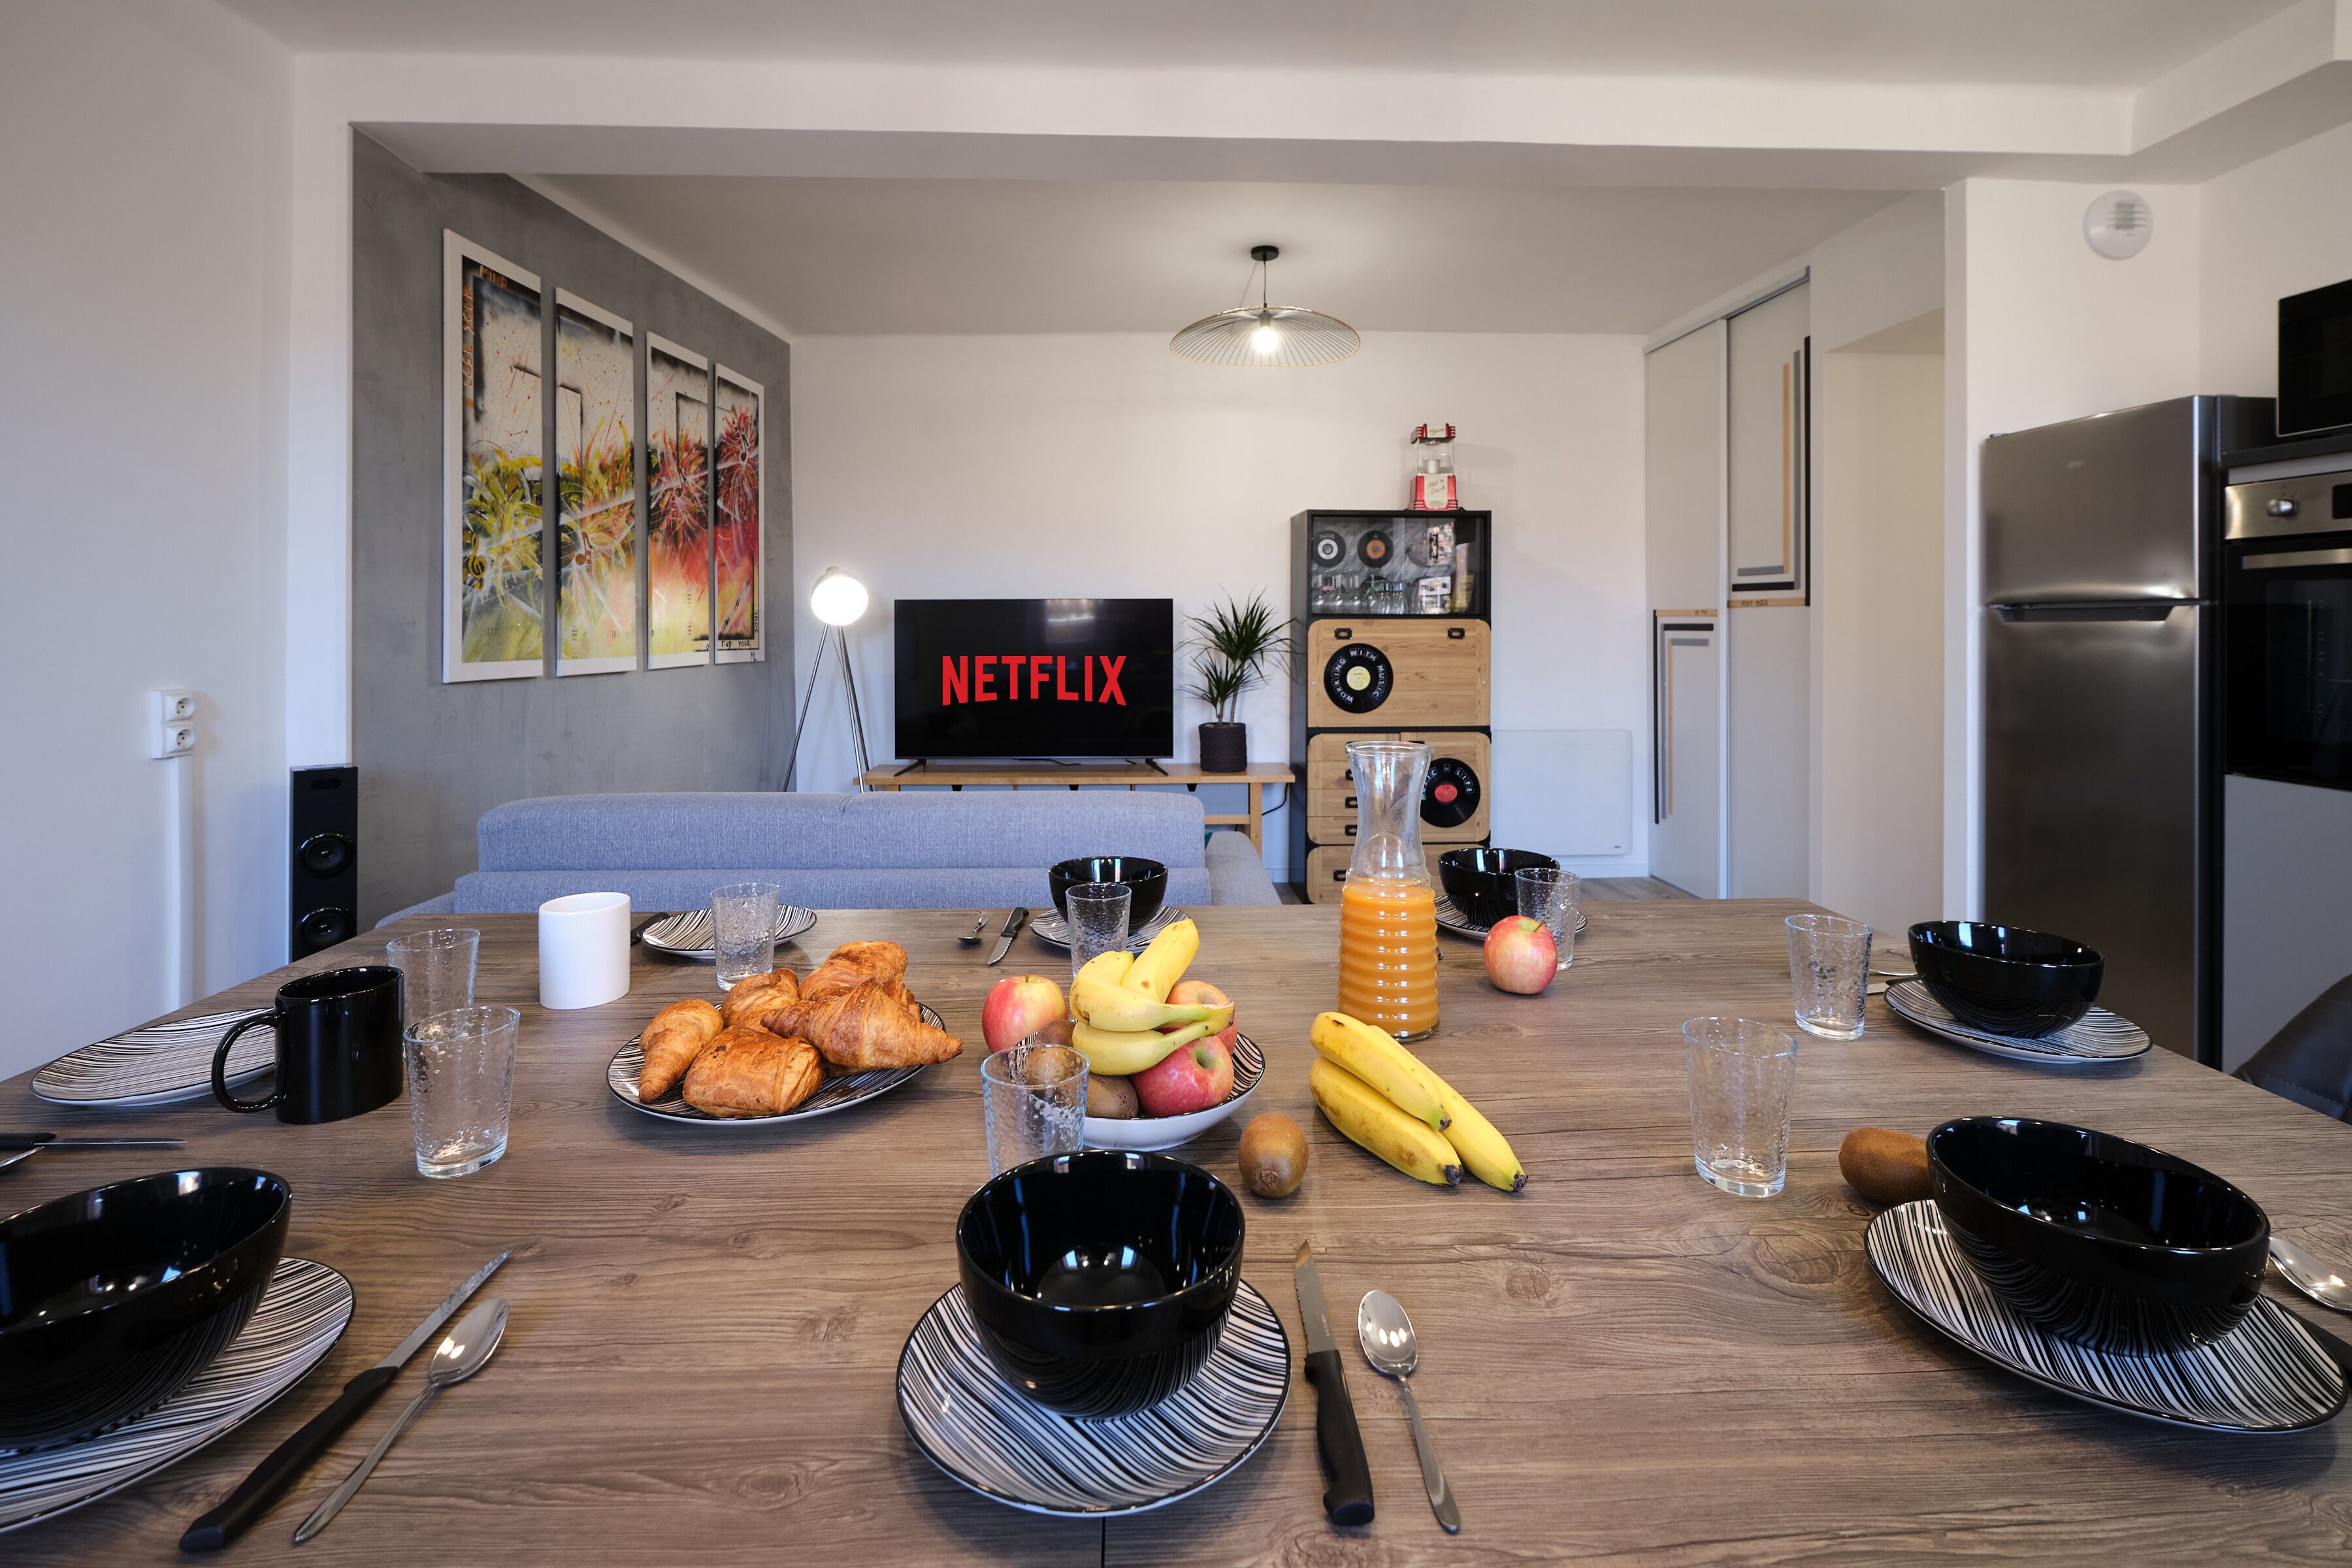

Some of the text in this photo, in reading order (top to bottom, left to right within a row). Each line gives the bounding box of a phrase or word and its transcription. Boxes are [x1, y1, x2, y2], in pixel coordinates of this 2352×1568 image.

[463, 285, 476, 387] LOSE YOUR
[942, 655, 1127, 706] NETFLIX
[1333, 649, 1385, 703] WORKING WITH MUSIC
[1457, 770, 1473, 792] LIFE
